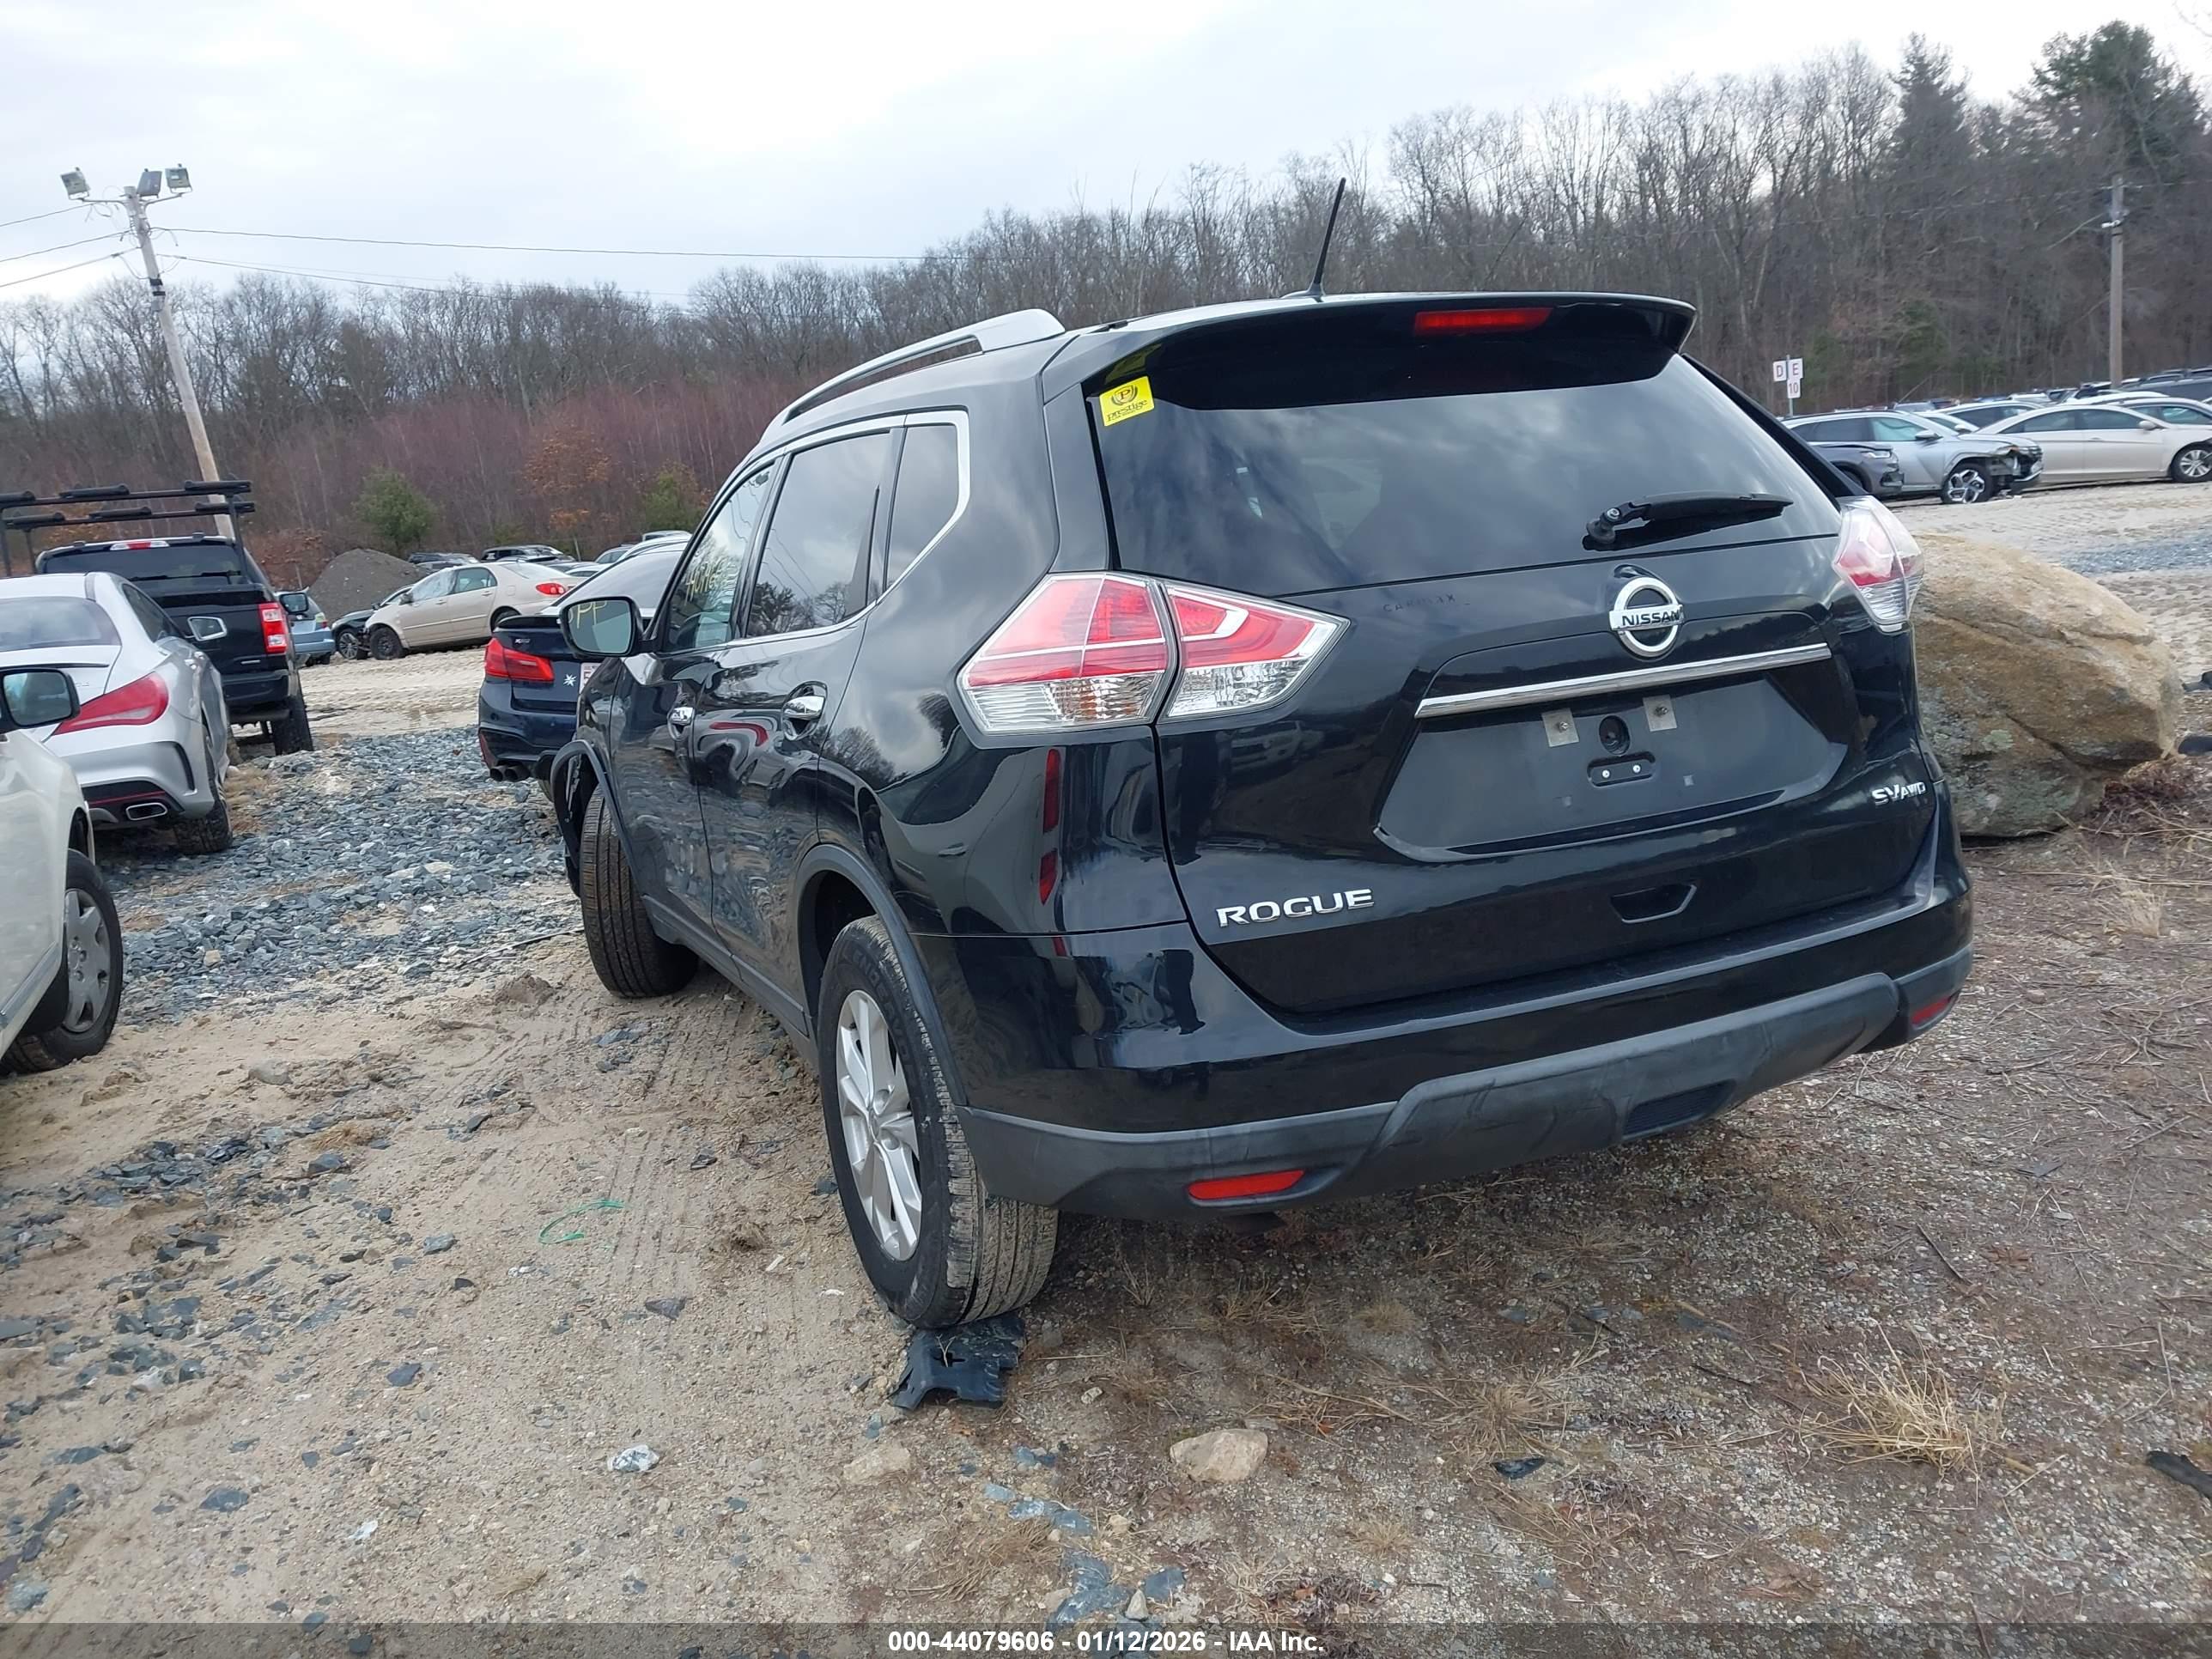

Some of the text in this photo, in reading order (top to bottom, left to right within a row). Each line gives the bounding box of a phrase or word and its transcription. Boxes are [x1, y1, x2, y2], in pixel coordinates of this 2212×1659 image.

[1776, 364, 1784, 378] D
[1792, 362, 1800, 376] E
[1789, 381, 1799, 394] 10
[1106, 399, 1148, 422] prestige
[1621, 608, 1680, 626] NISSAN
[1215, 888, 1374, 927] ROGUE
